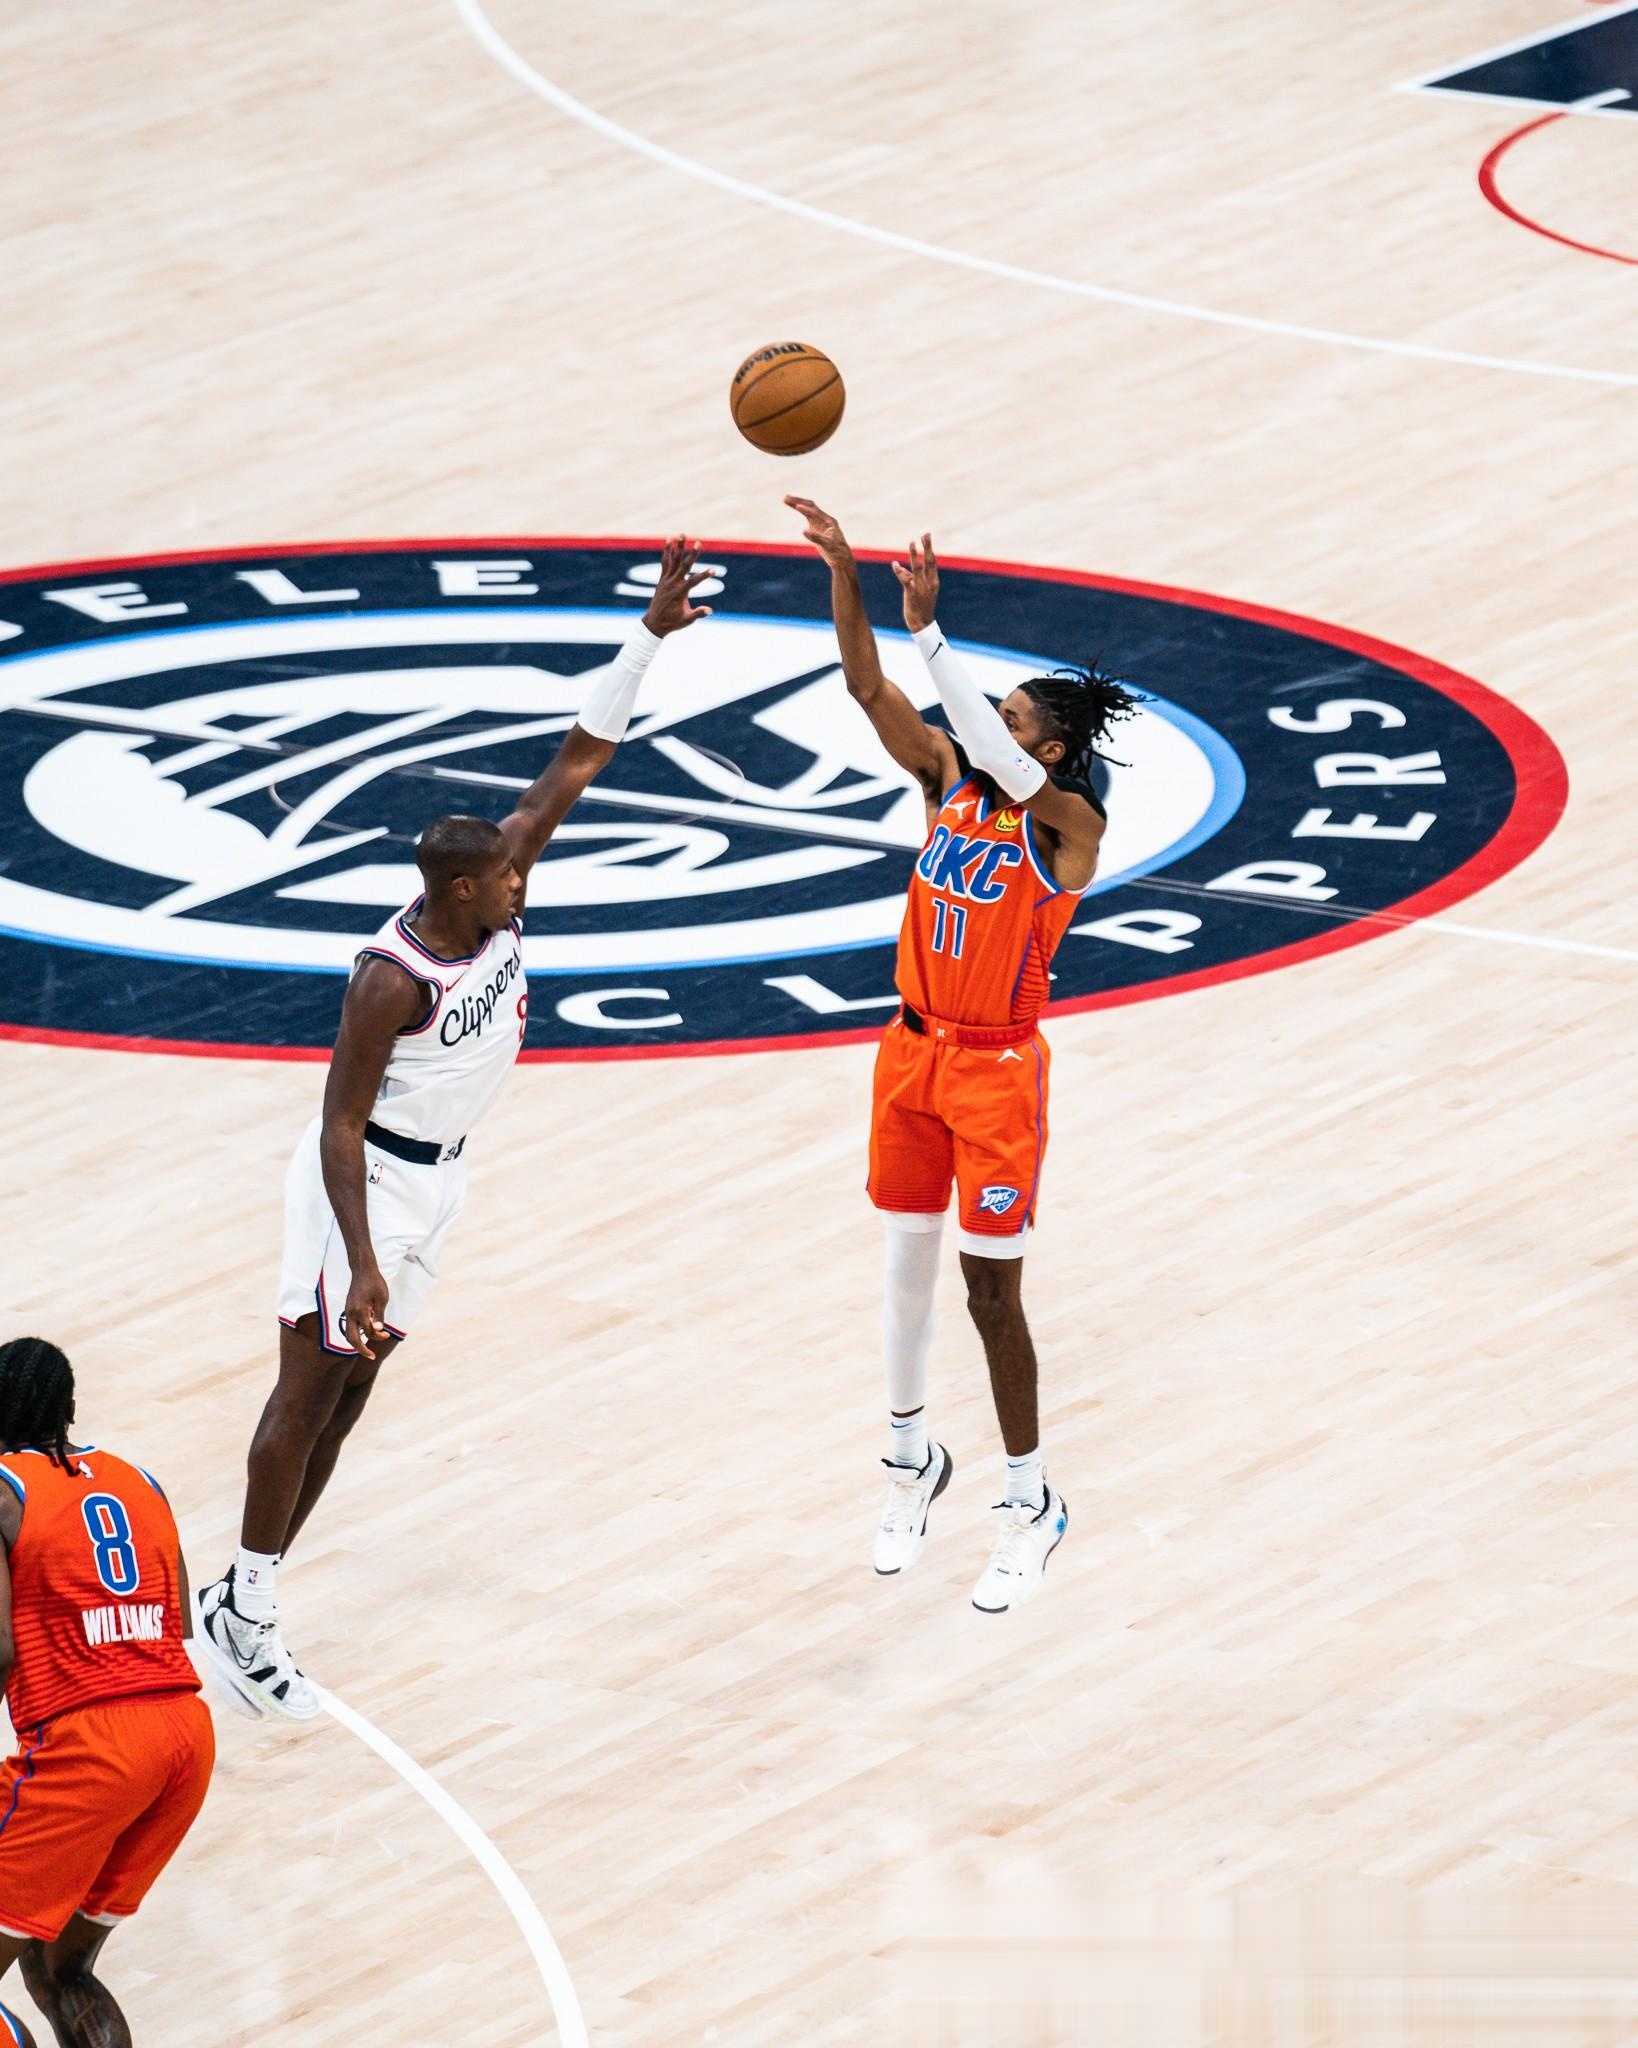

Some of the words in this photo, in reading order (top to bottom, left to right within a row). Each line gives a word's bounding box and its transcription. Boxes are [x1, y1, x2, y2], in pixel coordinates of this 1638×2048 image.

[917, 825, 1023, 903] OKC
[932, 898, 967, 960] 11
[440, 948, 520, 1046] Clippers
[82, 1493, 140, 1596] 8
[82, 1604, 164, 1646] WILLIAMS
